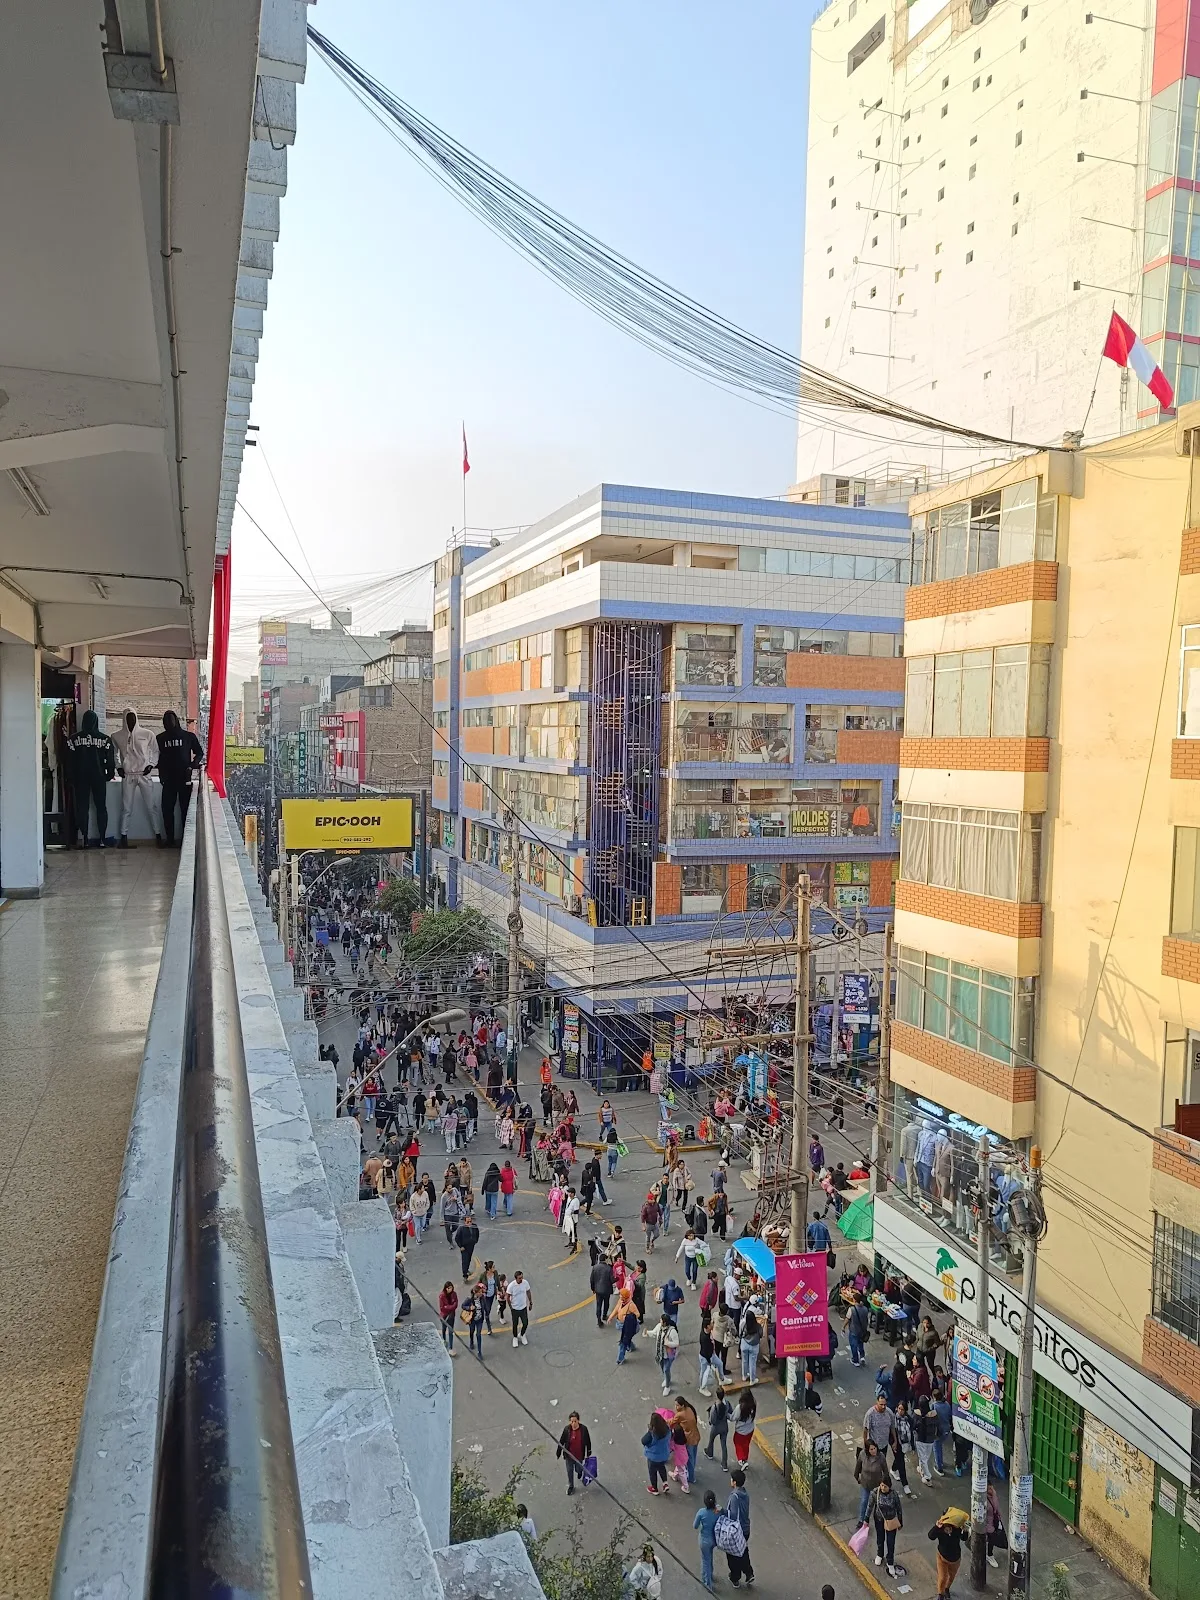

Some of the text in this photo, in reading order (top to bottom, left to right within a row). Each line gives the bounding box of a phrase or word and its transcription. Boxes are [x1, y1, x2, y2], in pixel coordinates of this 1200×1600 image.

[319, 716, 343, 727] GALERIAS
[792, 810, 829, 826] MOLDES
[787, 1259, 815, 1270] VICTORIA
[781, 1314, 824, 1326] Gamarra
[960, 1277, 1096, 1388] patanitos
